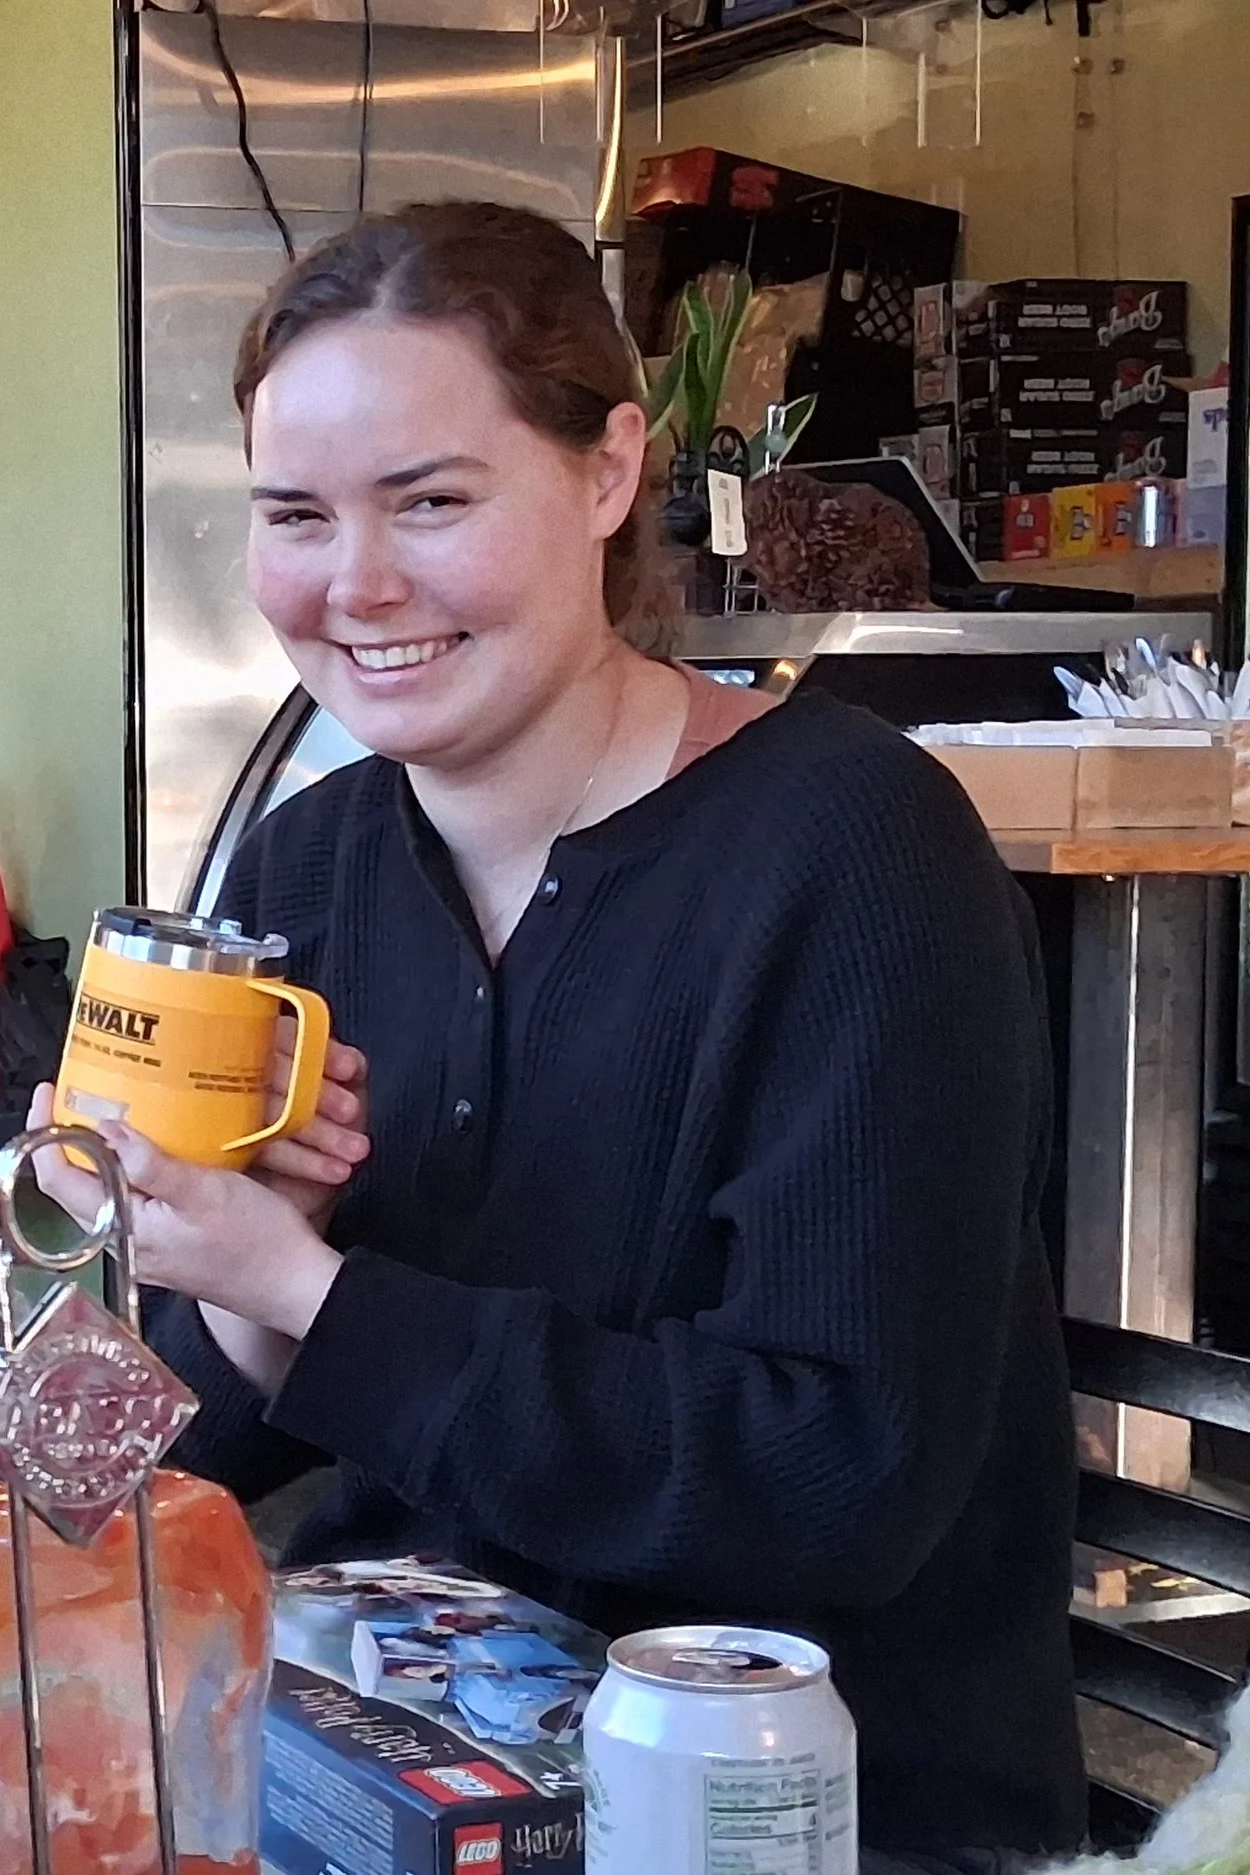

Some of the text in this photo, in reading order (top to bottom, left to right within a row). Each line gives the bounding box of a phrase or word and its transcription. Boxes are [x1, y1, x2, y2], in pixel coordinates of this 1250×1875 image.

[425, 1767, 500, 1799] LEGO
[458, 1839, 500, 1864] LEGO
[511, 1822, 574, 1860] Harry
